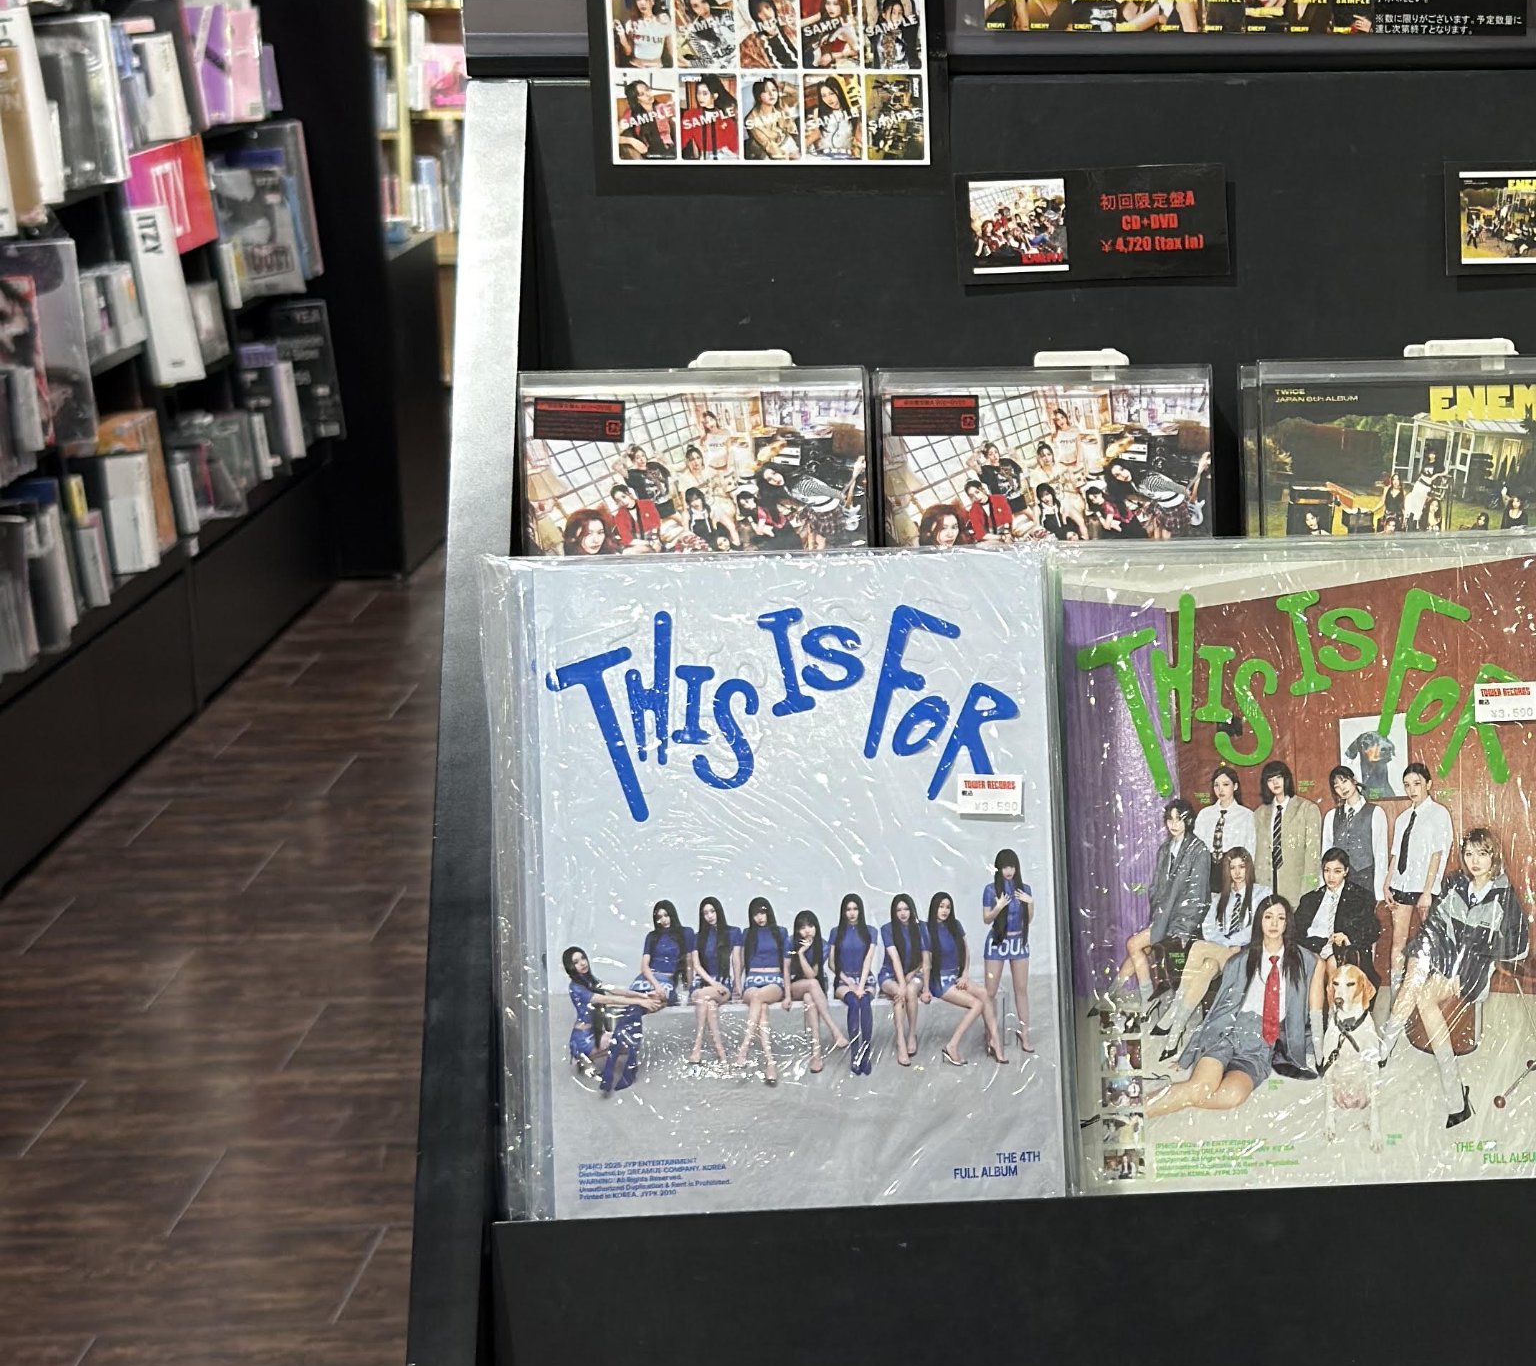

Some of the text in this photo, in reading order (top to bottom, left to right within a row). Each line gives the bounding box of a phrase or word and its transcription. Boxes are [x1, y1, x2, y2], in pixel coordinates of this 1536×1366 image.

[1100, 191, 1195, 210] 初回限定盤A
[1122, 214, 1178, 230] CD+DVD
[134, 214, 164, 256] ITZY
[1076, 588, 1521, 797] THIS IS FOR
[1481, 687, 1530, 697] TOWER RECORDS
[545, 604, 1019, 821] THIS IS FOR
[964, 780, 1016, 790] TOWER RECORDS
[953, 1165, 1018, 1180] FULL ALBUM
